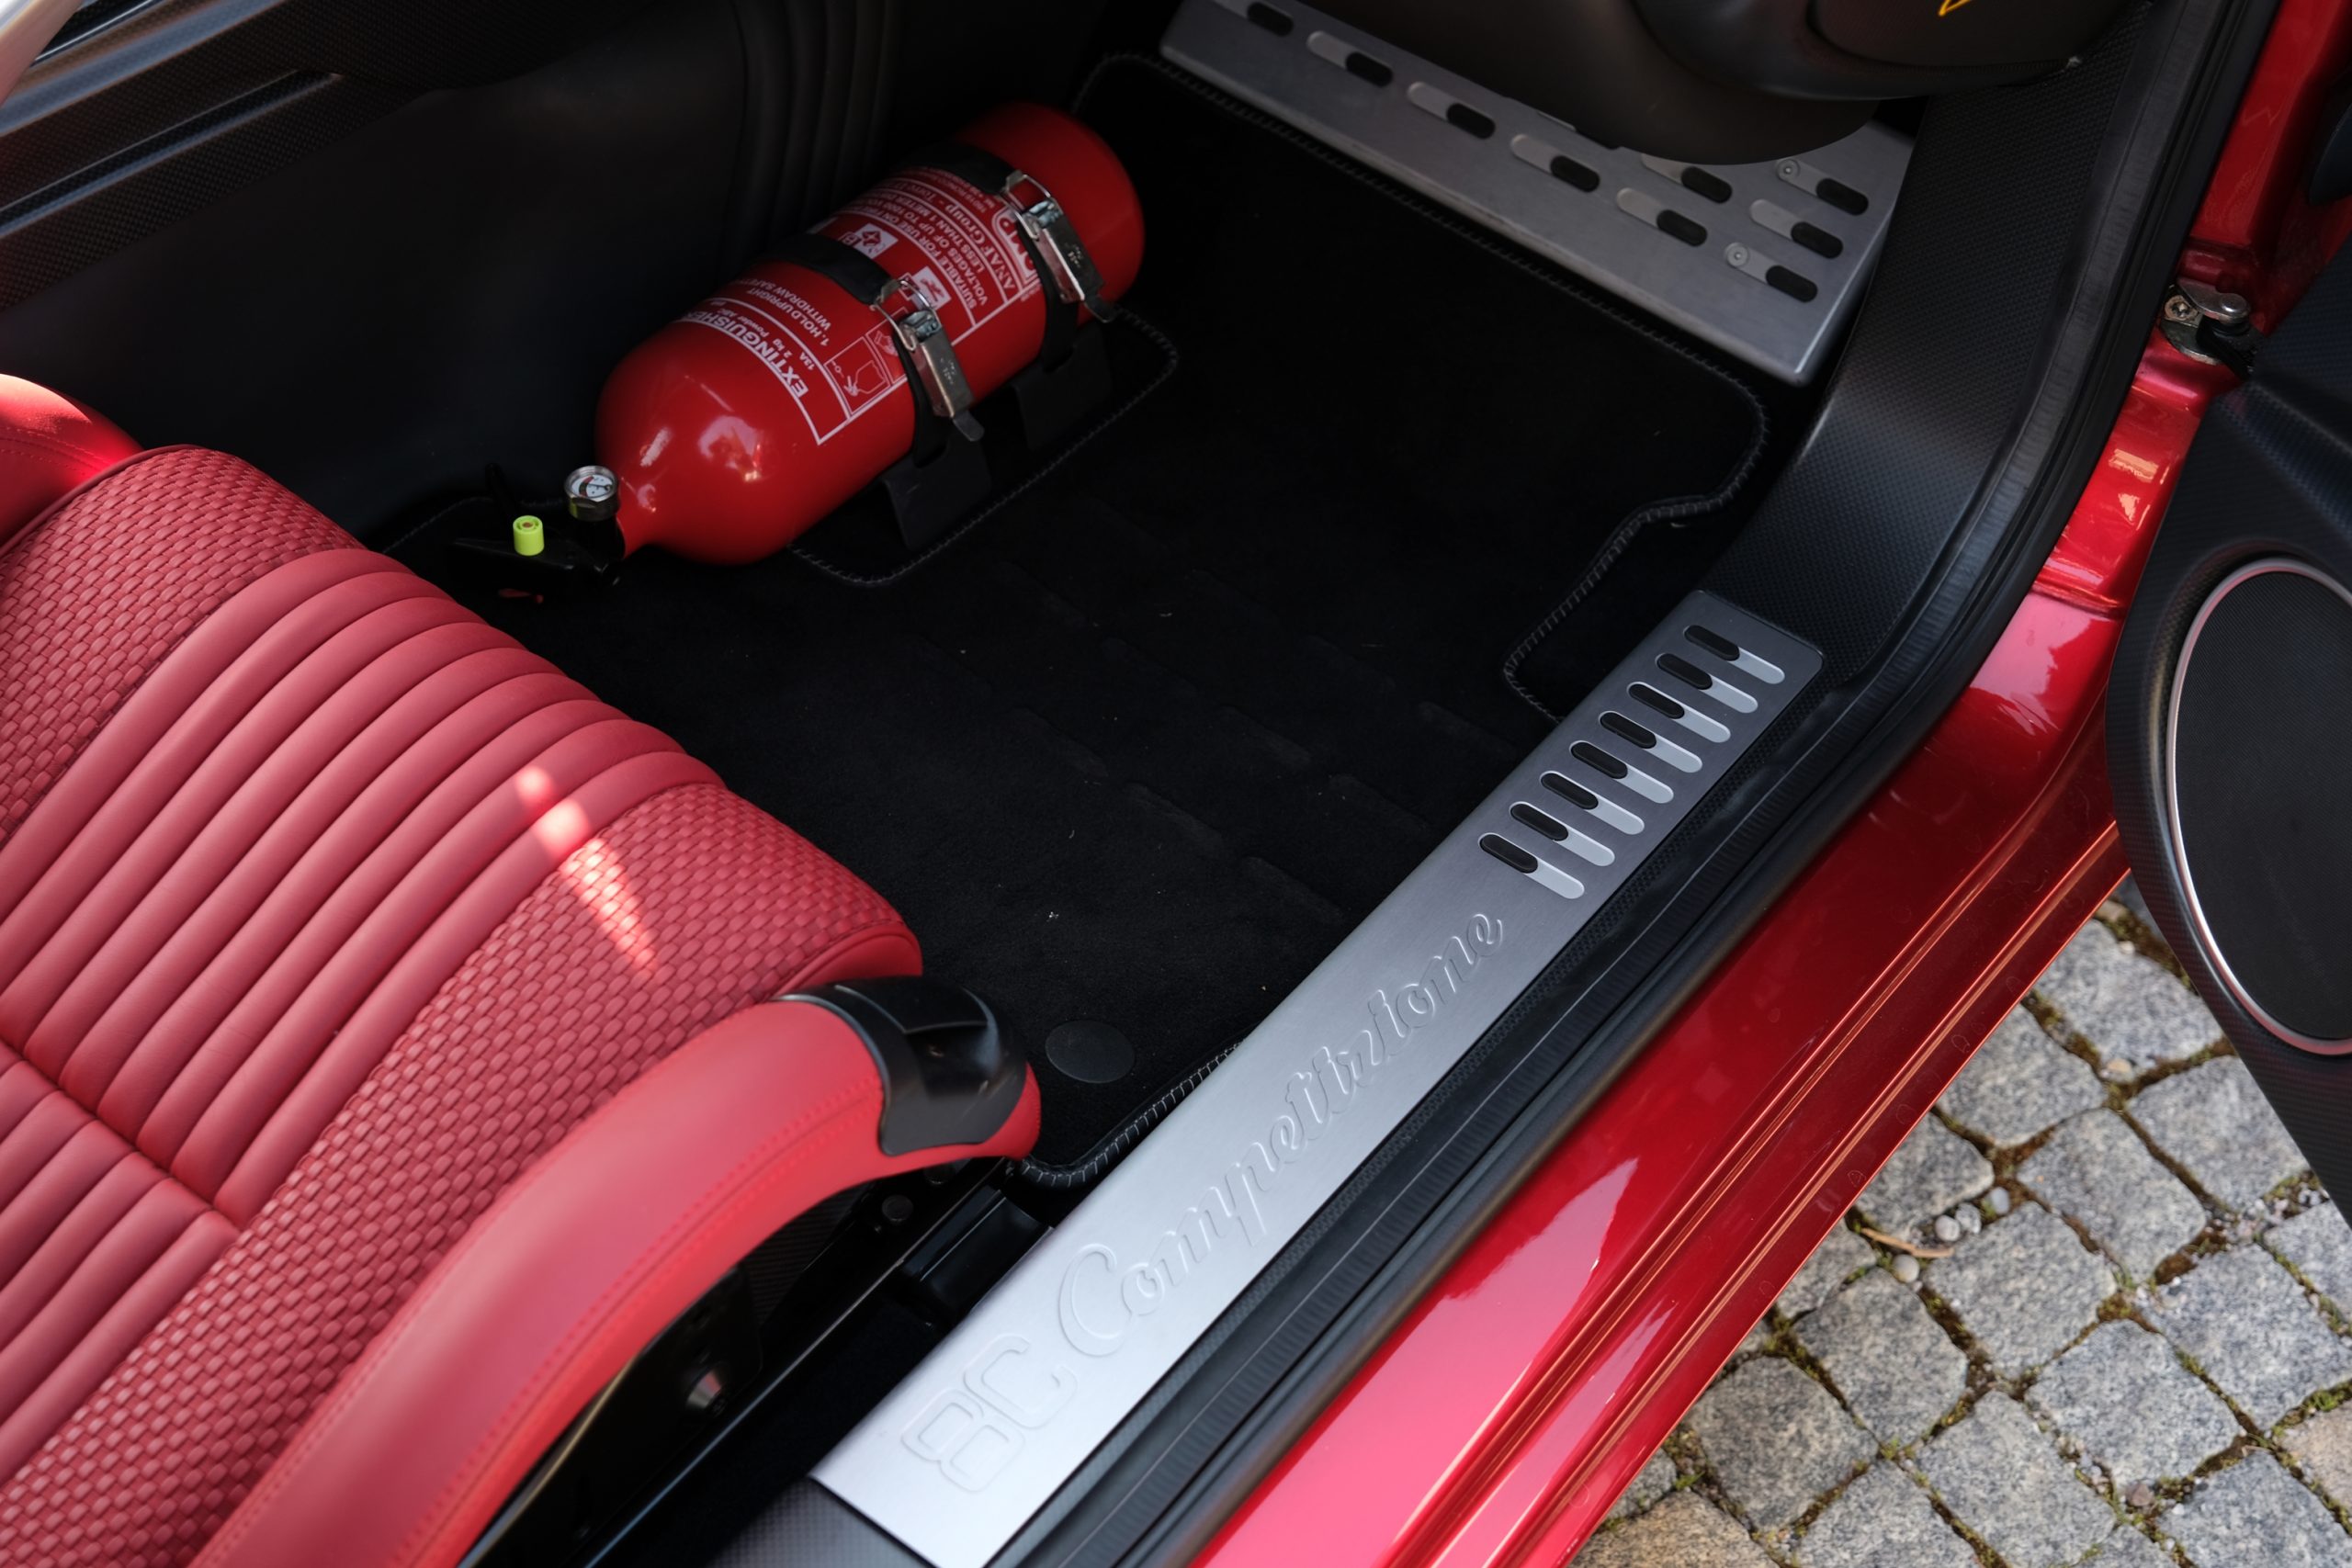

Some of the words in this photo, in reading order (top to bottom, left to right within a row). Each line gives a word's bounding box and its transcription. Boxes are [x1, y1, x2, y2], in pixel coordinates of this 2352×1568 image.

[898, 220, 921, 237] USE
[903, 209, 920, 223] TO
[917, 219, 936, 234] UP
[943, 202, 986, 245] Group
[918, 234, 942, 257] FOR
[932, 231, 951, 247] OF
[935, 218, 964, 247] THAN
[959, 243, 986, 273] LESS
[978, 243, 1016, 290] ANAF
[937, 254, 978, 309] SUITABLE
[946, 245, 987, 305] VOLTAGES
[745, 285, 794, 314] UPRIGHT
[772, 285, 831, 330] WITHDRAW
[735, 313, 770, 338] Powder
[789, 309, 822, 338] HOLD
[899, 1334, 1078, 1493] 8C
[1058, 913, 1504, 1358] Competizione
